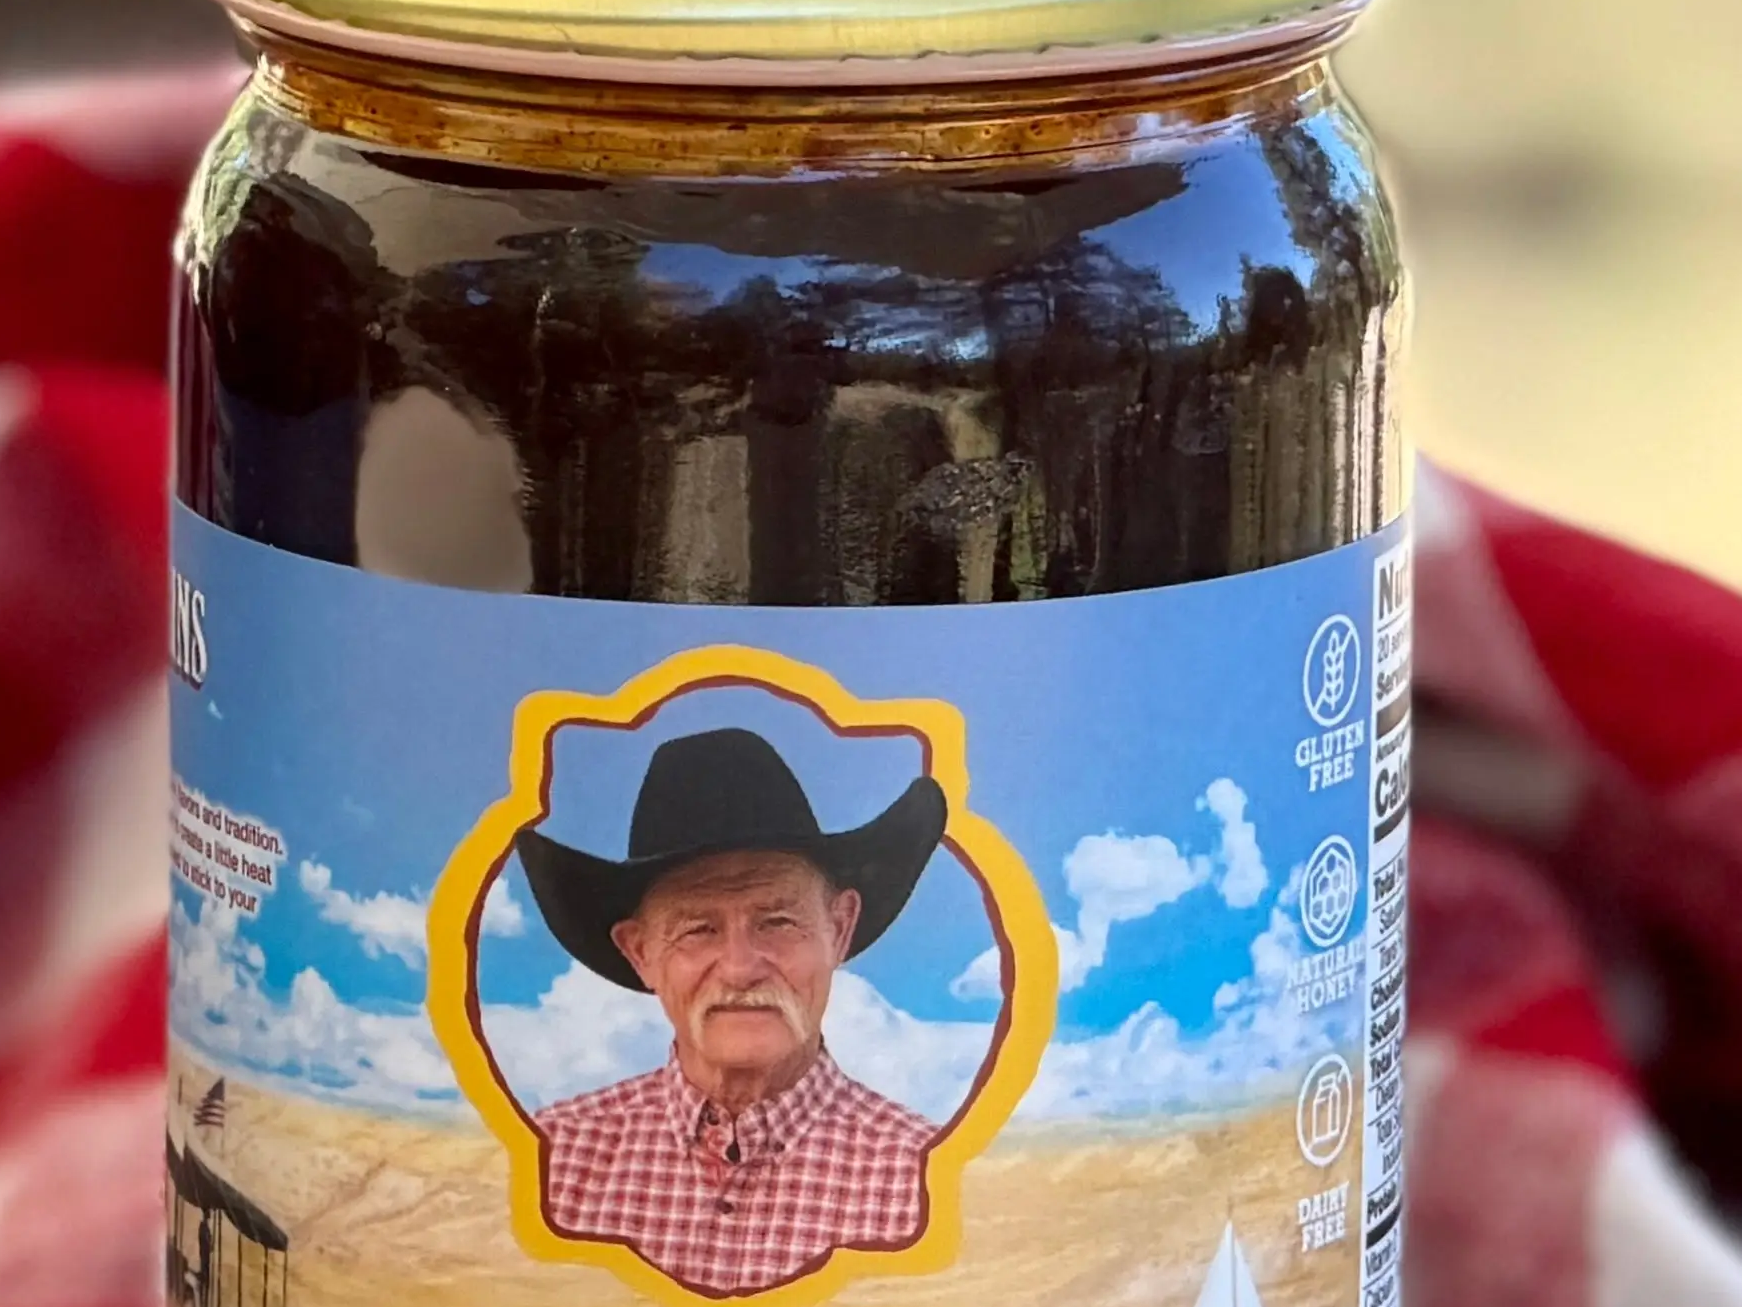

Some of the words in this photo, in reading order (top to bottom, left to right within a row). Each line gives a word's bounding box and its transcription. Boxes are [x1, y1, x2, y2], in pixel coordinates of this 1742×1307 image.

[1295, 718, 1365, 768] GLUTEN
[1308, 752, 1355, 793] FREE
[202, 806, 222, 831] and
[224, 815, 283, 855] tradition.
[241, 853, 272, 886] heat
[228, 885, 257, 913] your
[1285, 935, 1366, 992] NATURAL
[1296, 969, 1357, 1014] HONEY
[1297, 1180, 1350, 1225] DAIRY
[1300, 1210, 1346, 1254] FREE
